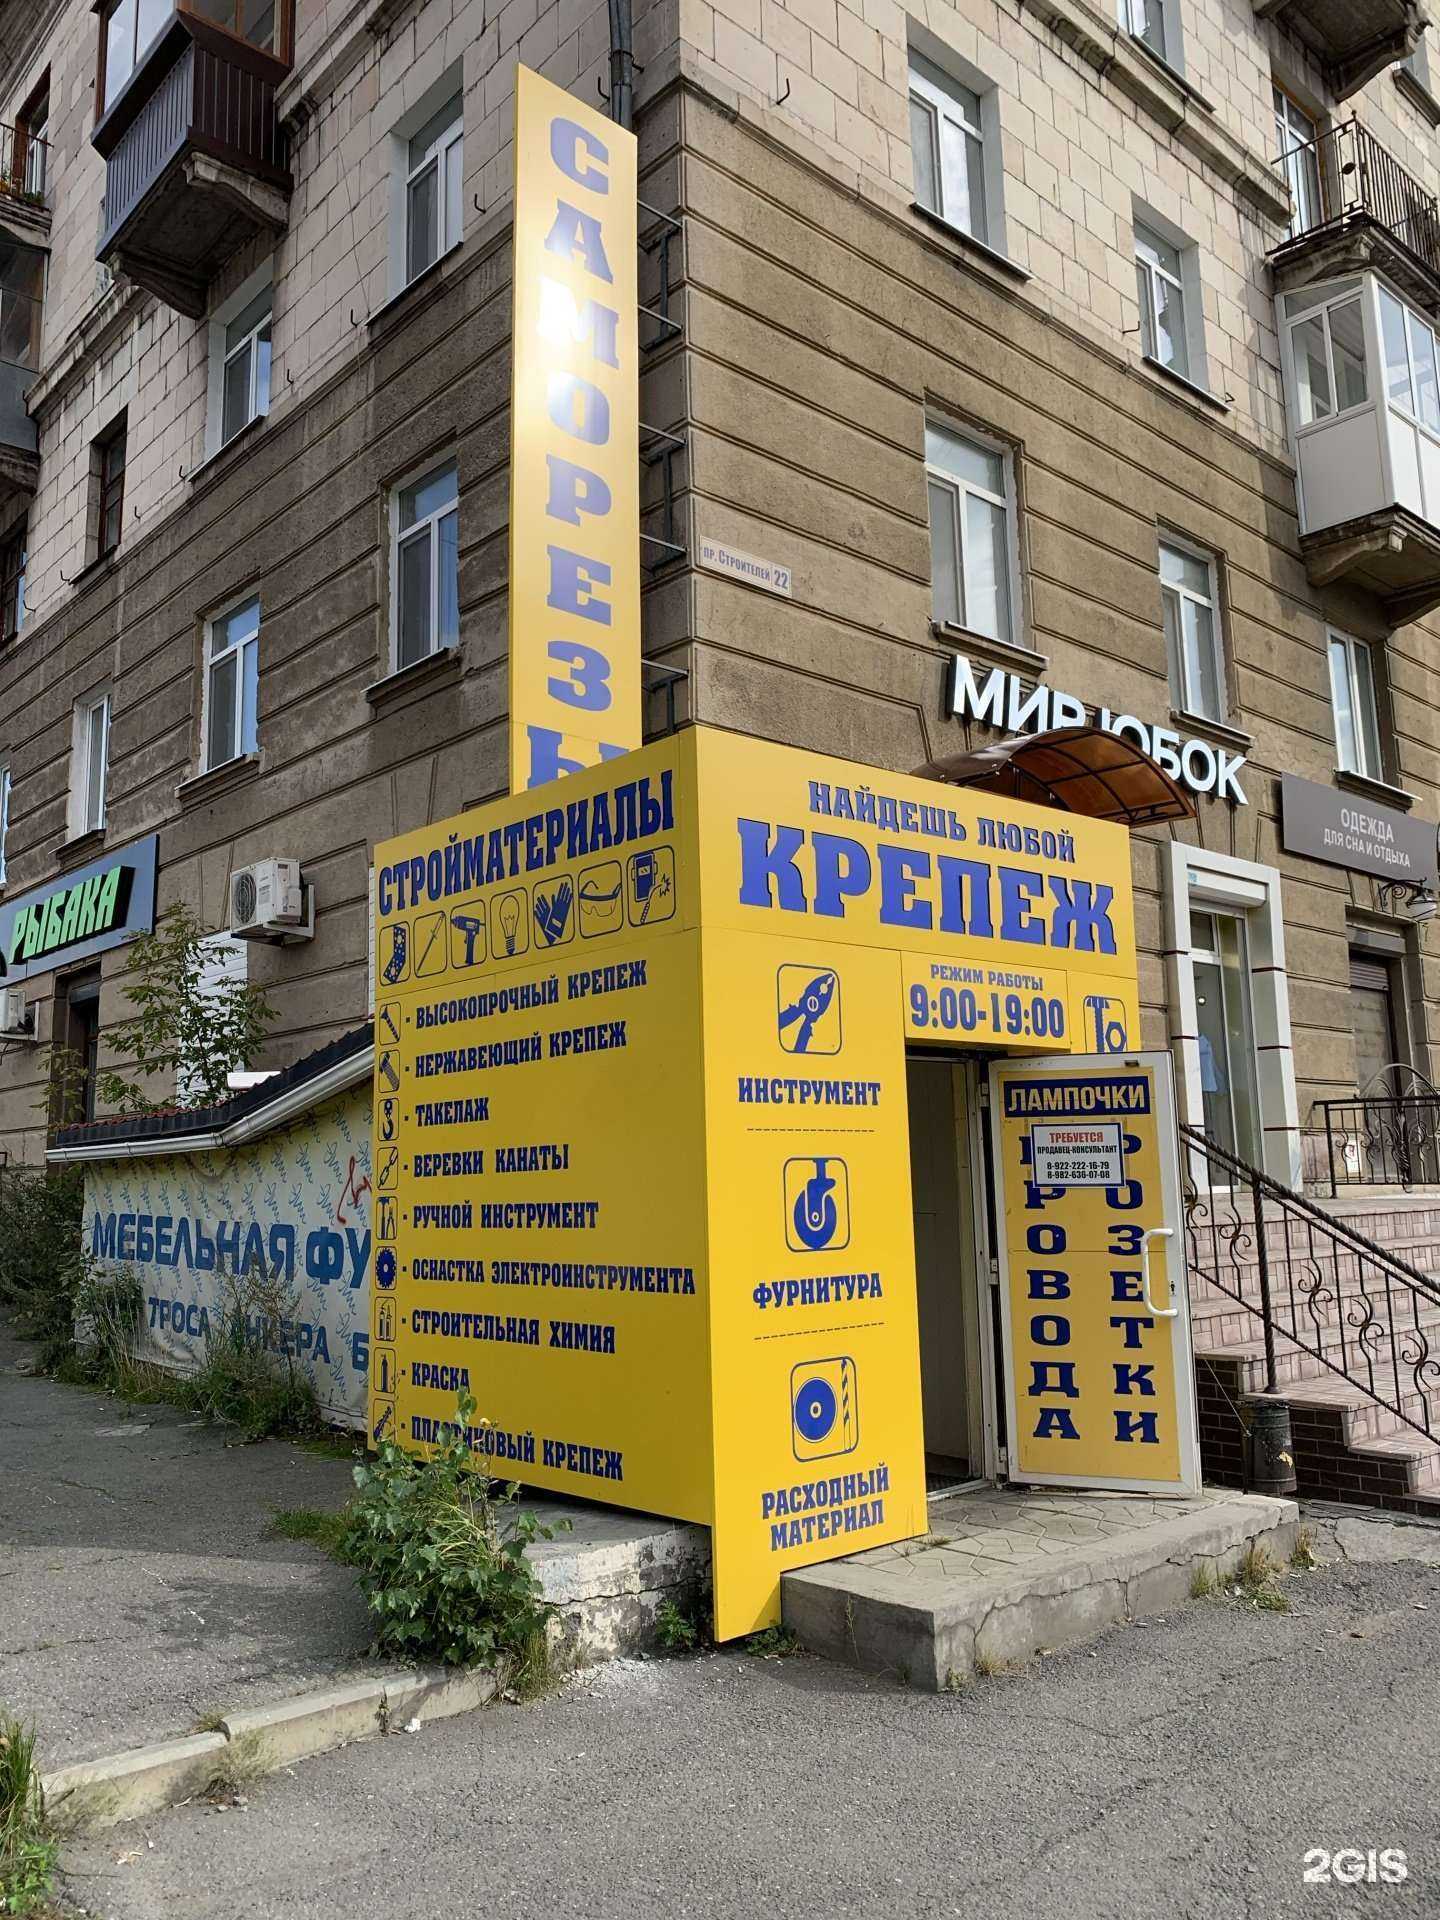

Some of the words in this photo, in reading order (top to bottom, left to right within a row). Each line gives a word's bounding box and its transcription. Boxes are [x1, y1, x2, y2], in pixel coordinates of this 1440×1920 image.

[774, 569, 789, 590] 22
[952, 654, 1086, 733] МИР
[807, 780, 968, 843] НАЙДЕШЬ
[977, 816, 1075, 864] ЛЮБОЙ
[1340, 808, 1395, 843] ОДЕЖДА
[378, 769, 674, 917] СТРОЙМАТЕРИАЛЫ
[1323, 828, 1344, 847] ДЛЯ
[1345, 833, 1365, 852] СНА
[1365, 839, 1373, 856] И
[1374, 844, 1411, 868] ОТДЫХА
[737, 817, 1118, 956] КРЕПЕЖ
[8, 865, 122, 965] РЫБАКА
[415, 974, 559, 1030] ВЫСОКОПРОЧНЫЙ
[567, 959, 647, 1001] КРЕПЕЖ
[930, 963, 984, 984] РЕЖИМ
[988, 970, 1044, 992] РАБОТЫ
[910, 983, 1065, 1039] 9:00-19:00
[415, 1032, 542, 1079] НЕРЖАВЕЮЩИЙ
[549, 1020, 627, 1058] КРЕПЕЖ
[737, 1076, 881, 1106] ИНСТРУМЕНТ
[1008, 1083, 1146, 1113] ЛАМПОЧКИ
[415, 1097, 490, 1128] ТАКЕЛАЖ
[1037, 1145, 1118, 1155] ПРОДАВЕЦ-КОНСУЛЬТАНТ
[1049, 1131, 1104, 1143] ТРЕБУЕТСЯ
[413, 1150, 484, 1178] ВЕРЕВКИ
[495, 1144, 569, 1174] КАНАТЫ
[1047, 1161, 1110, 1170] 8-922-222-16-79
[412, 1200, 473, 1229] РУЧНОЙ
[480, 1202, 599, 1229] ИНСТРУМЕНТ
[92, 1211, 295, 1283] МЕБЕЛЬНАЯ
[411, 1258, 485, 1283] ОСНАСТКА
[490, 1261, 696, 1295] ЭЛЕКТРОИНСТРУМЕНТА
[752, 1272, 882, 1309] ФУРНИТУРА
[411, 1309, 540, 1346] СТРОИТЕЛЬНАЯ
[549, 1320, 616, 1354] ХИМИЯ
[411, 1362, 471, 1393] КРАСКА
[543, 1439, 623, 1481] КРЕПЕЖ
[761, 1462, 889, 1519] РАСХОДНЫЙ
[770, 1499, 884, 1552] МАТЕРИАЛ
